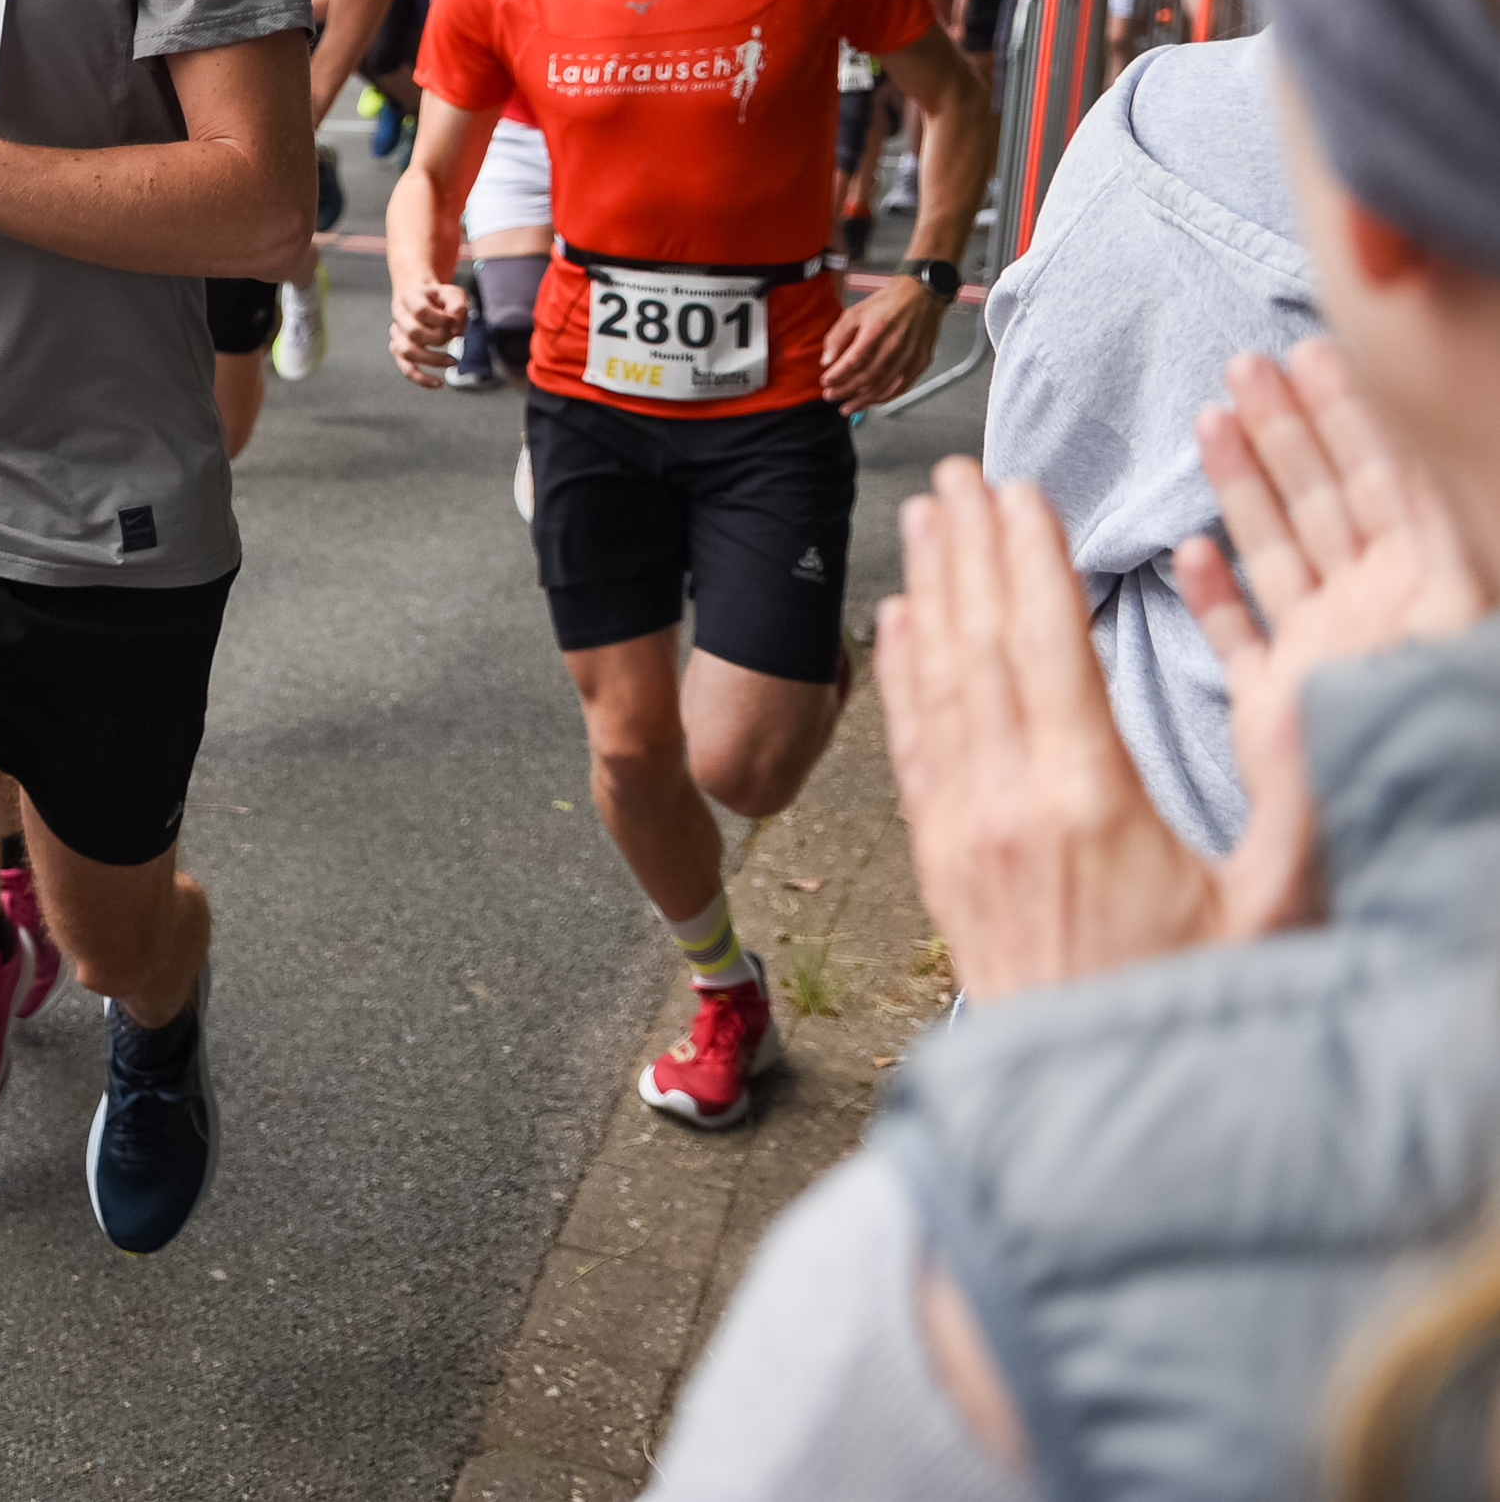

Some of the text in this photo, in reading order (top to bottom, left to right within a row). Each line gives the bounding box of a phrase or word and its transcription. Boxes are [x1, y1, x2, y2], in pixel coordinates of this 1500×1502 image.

[547, 54, 732, 84] Laufrausch
[598, 291, 752, 349] 2801
[605, 357, 665, 387] EWE
